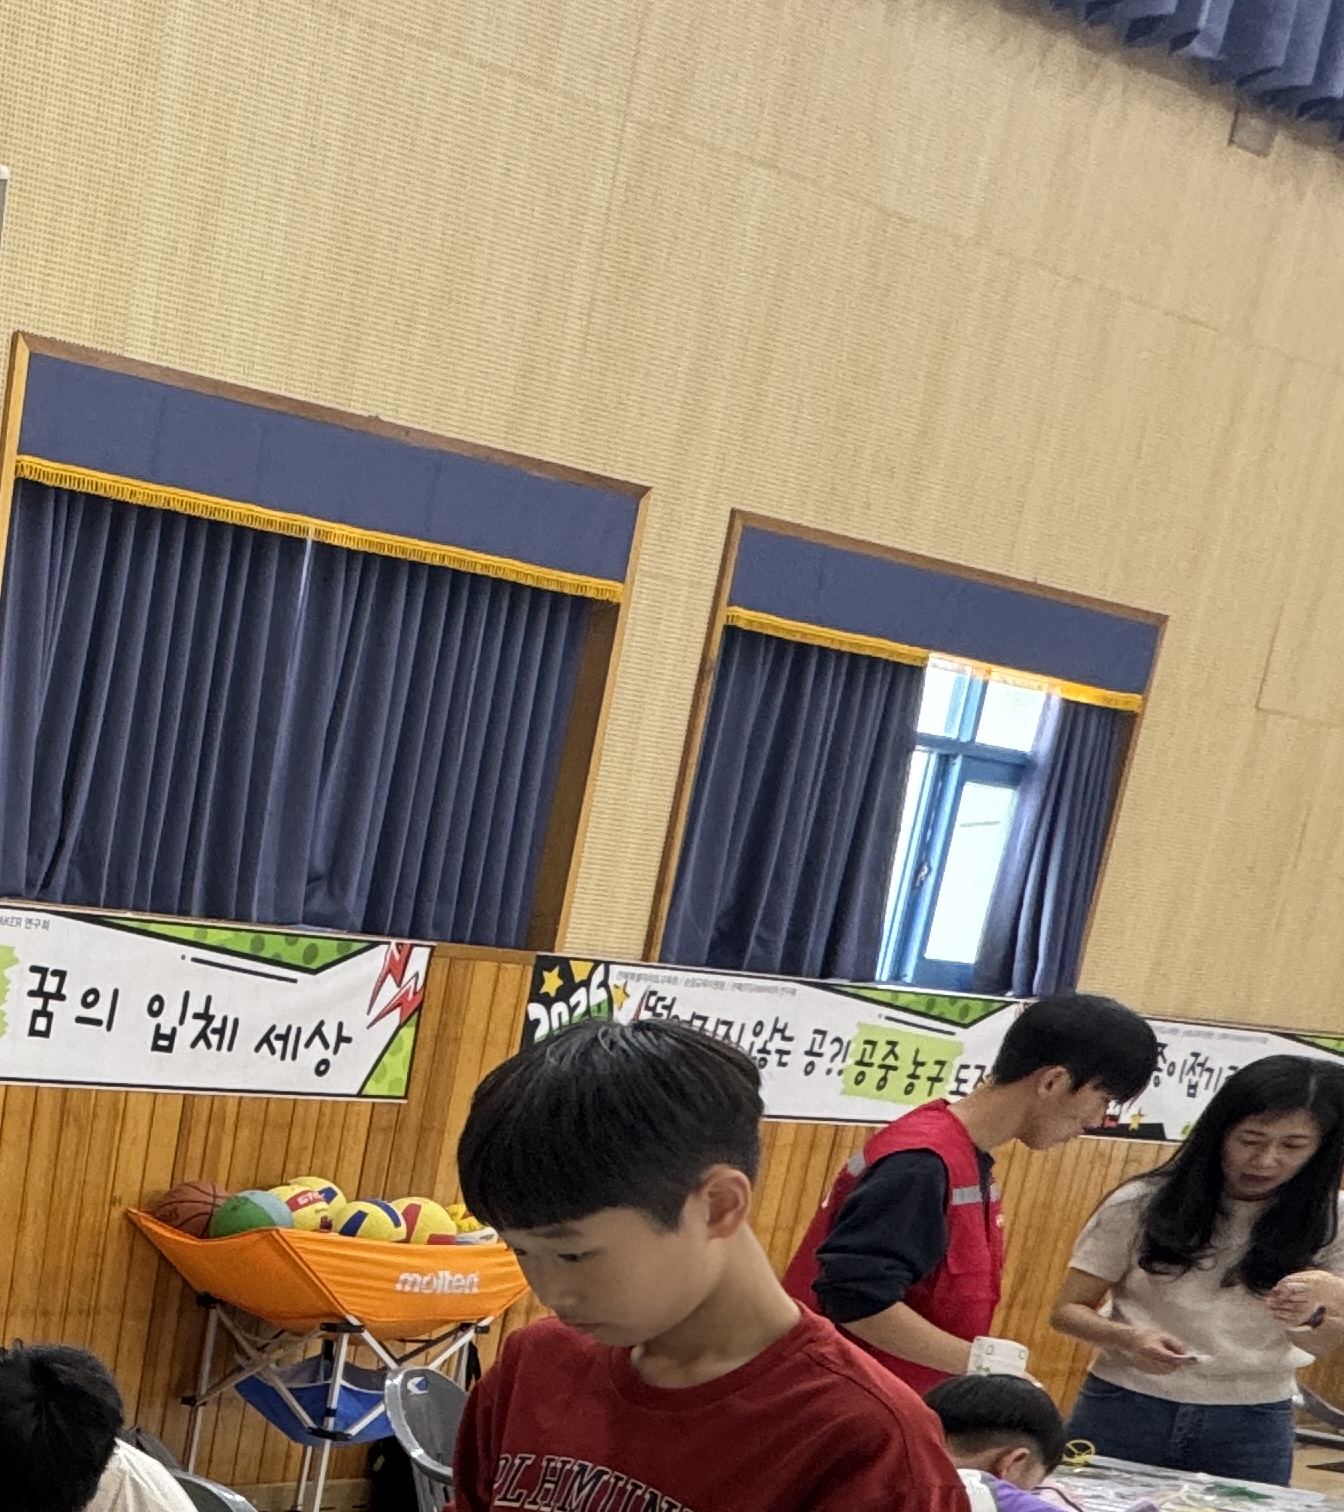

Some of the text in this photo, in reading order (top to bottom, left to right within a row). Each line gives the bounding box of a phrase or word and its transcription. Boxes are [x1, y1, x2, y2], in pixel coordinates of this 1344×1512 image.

[26, 964, 119, 1039] 꿈의
[146, 990, 237, 1055] 입체
[253, 1013, 353, 1079] 세상
[854, 1039, 900, 1092] 공중
[904, 1047, 948, 1098] 농구
[395, 1270, 480, 1294] molten
